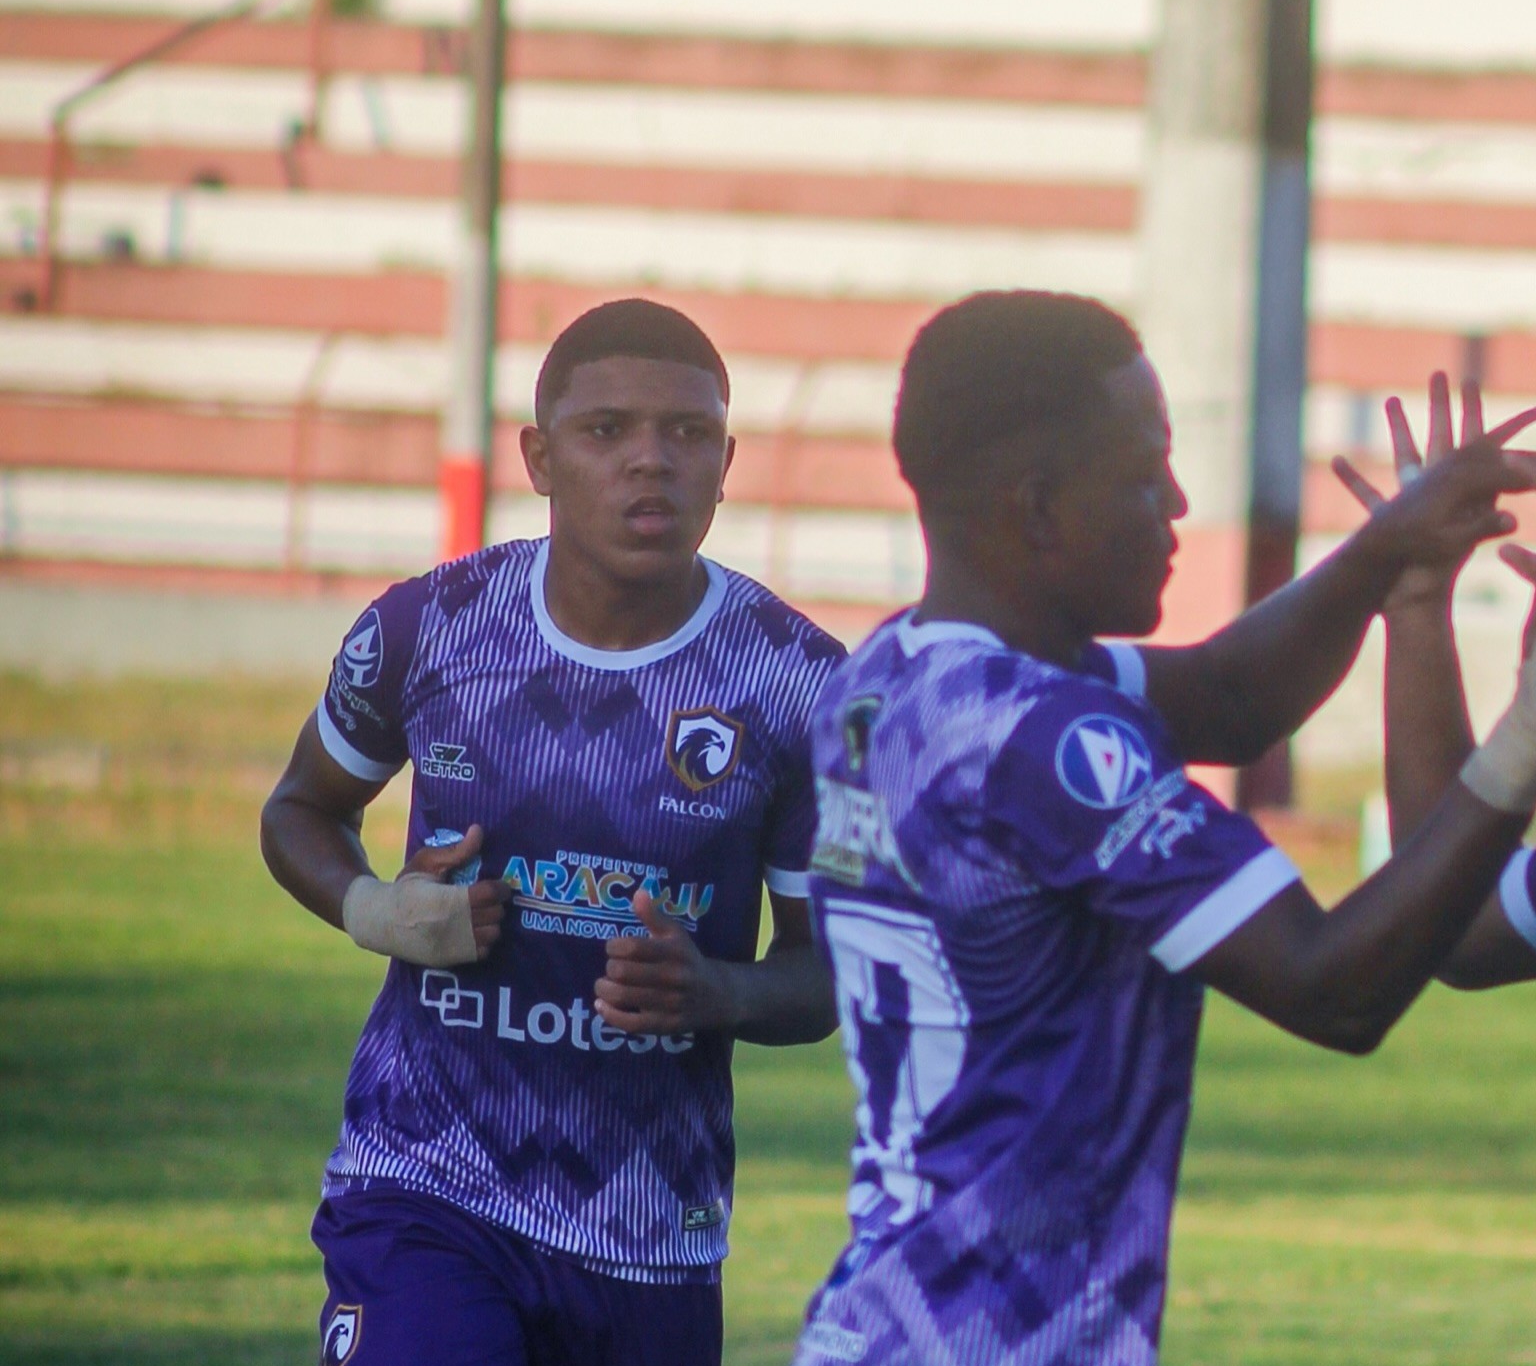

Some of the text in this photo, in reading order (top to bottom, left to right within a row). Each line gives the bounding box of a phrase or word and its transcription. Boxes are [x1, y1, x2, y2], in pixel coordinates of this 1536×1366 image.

[421, 757, 476, 782] RETRO
[658, 795, 727, 820] FALCON
[556, 850, 669, 879] PREFEITURA
[521, 911, 563, 933] UMA
[566, 918, 619, 940] NOVA
